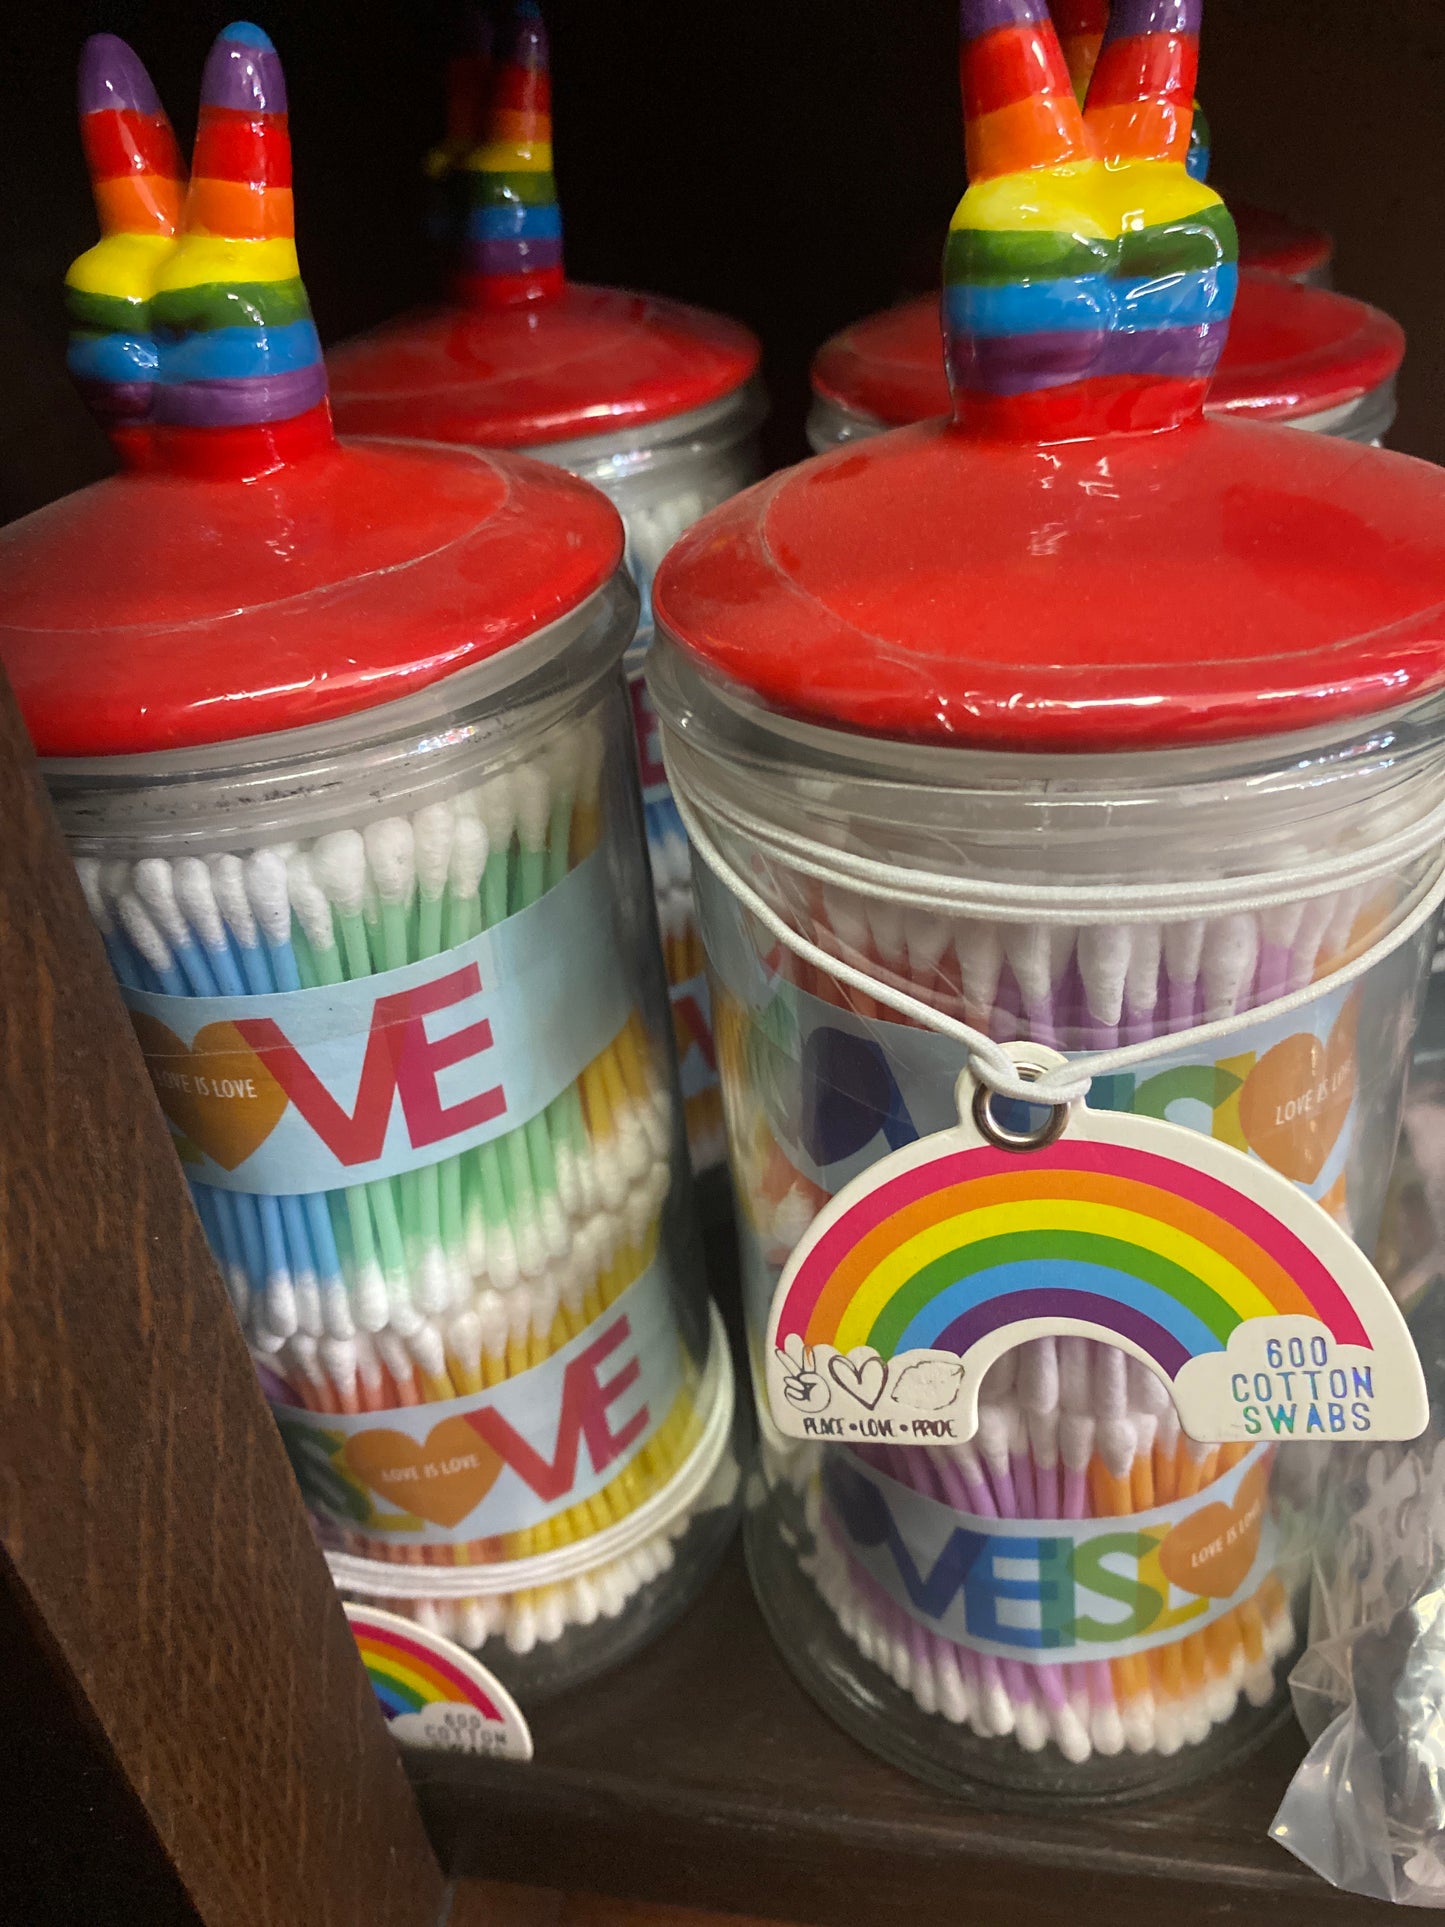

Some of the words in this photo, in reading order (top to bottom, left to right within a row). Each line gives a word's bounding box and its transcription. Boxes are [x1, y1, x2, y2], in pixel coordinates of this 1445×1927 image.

[194, 1076, 209, 1096] IS
[211, 1078, 258, 1099] LOVE
[1275, 1088, 1314, 1126] LOVE
[1267, 1335, 1328, 1369] 600
[1231, 1366, 1375, 1403] COTTON
[859, 1418, 898, 1438] LOVE
[911, 1420, 958, 1438] PRIDE
[1242, 1402, 1371, 1435] SWABS
[381, 1465, 419, 1482] LOVE
[423, 1461, 440, 1479] IS
[440, 1453, 481, 1476] LOVE
[1191, 1534, 1224, 1569] LOVE
[423, 1723, 507, 1746] COTTON
